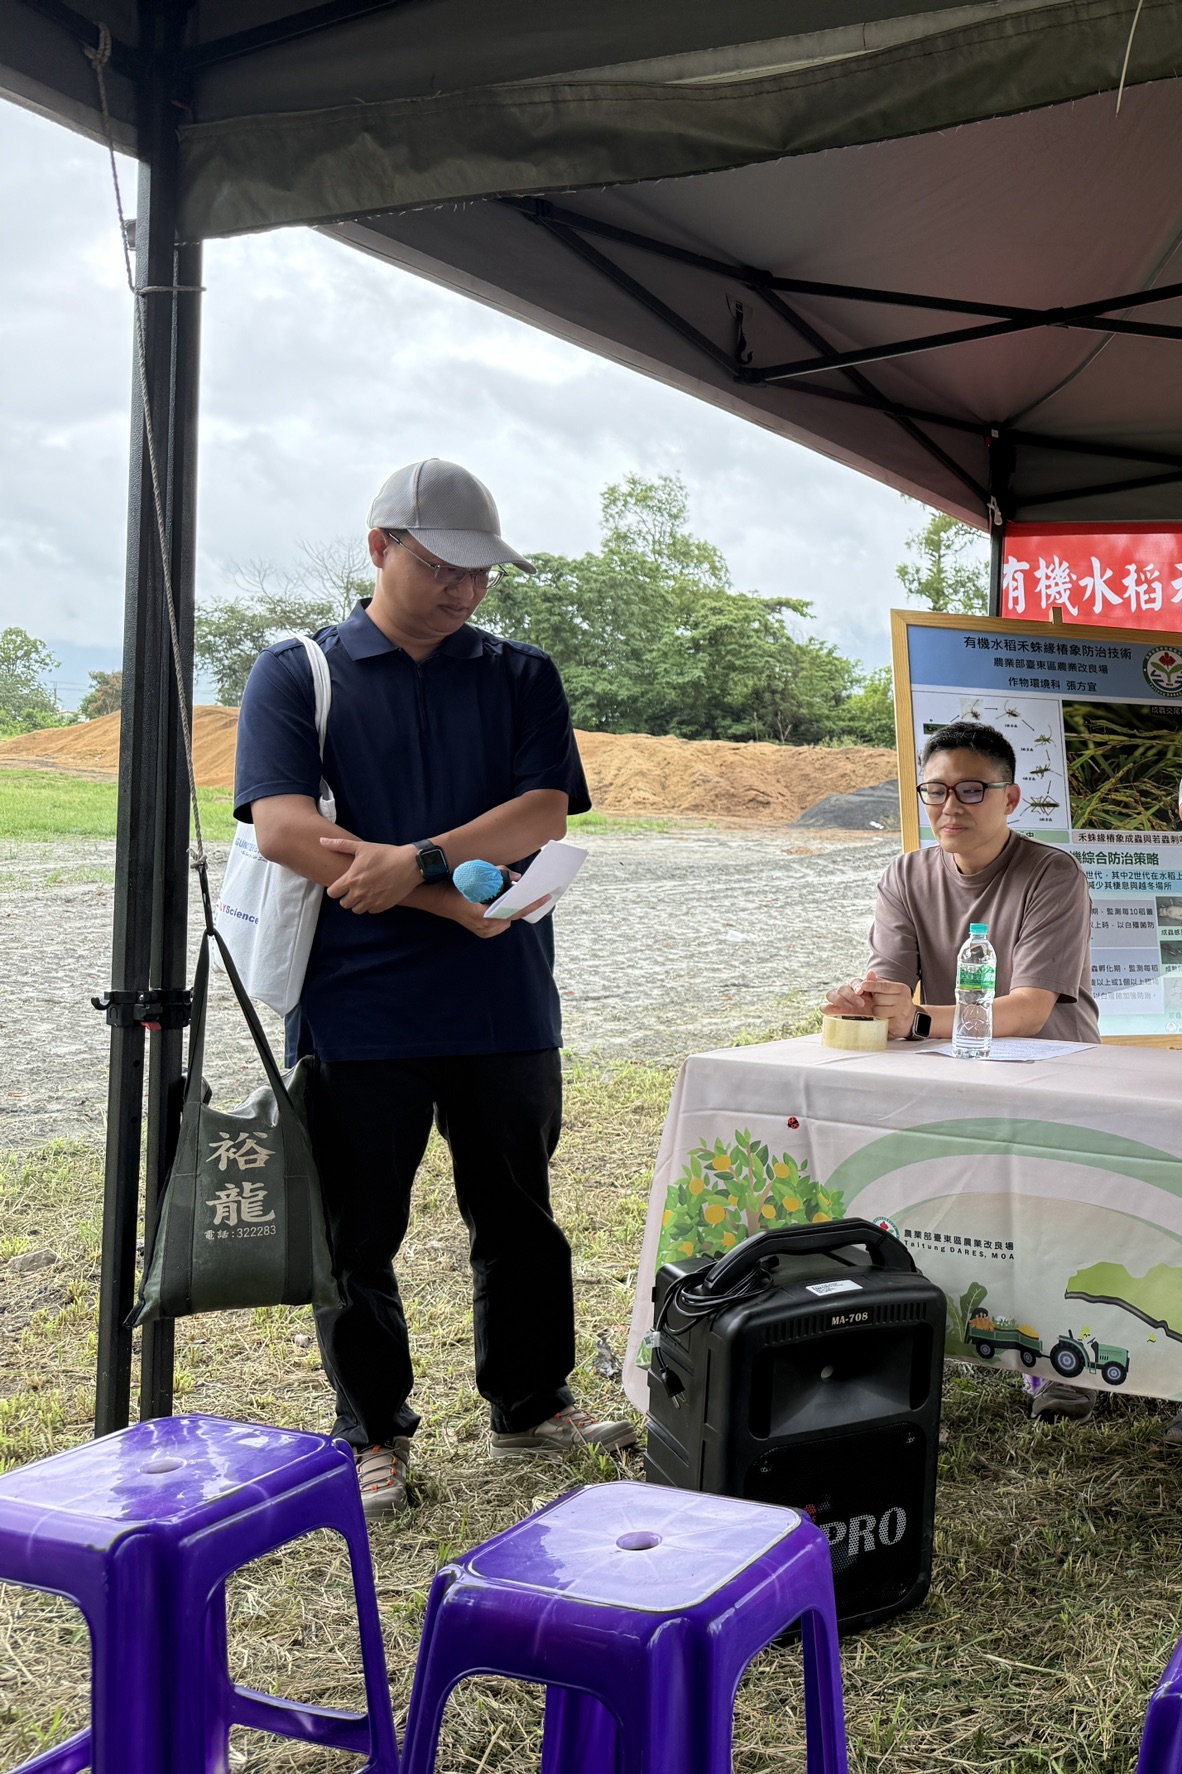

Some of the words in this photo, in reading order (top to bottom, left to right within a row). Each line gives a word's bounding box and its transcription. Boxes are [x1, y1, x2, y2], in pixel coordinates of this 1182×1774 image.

[963, 636, 1132, 660] 有機水稻禾蛛緣椿象防治技術
[993, 657, 1109, 675] 農業部臺東區農業改良場
[1008, 677, 1061, 690] 作物環境科
[1066, 679, 1097, 692] 張方宜
[205, 1131, 276, 1226] 裕龍
[904, 1229, 1014, 1251] 農業部臺東區農業改良場
[904, 1240, 946, 1253] Taitung
[949, 1246, 987, 1259] DARES,
[991, 1252, 1015, 1260] MOA
[831, 1311, 869, 1326] MA-708
